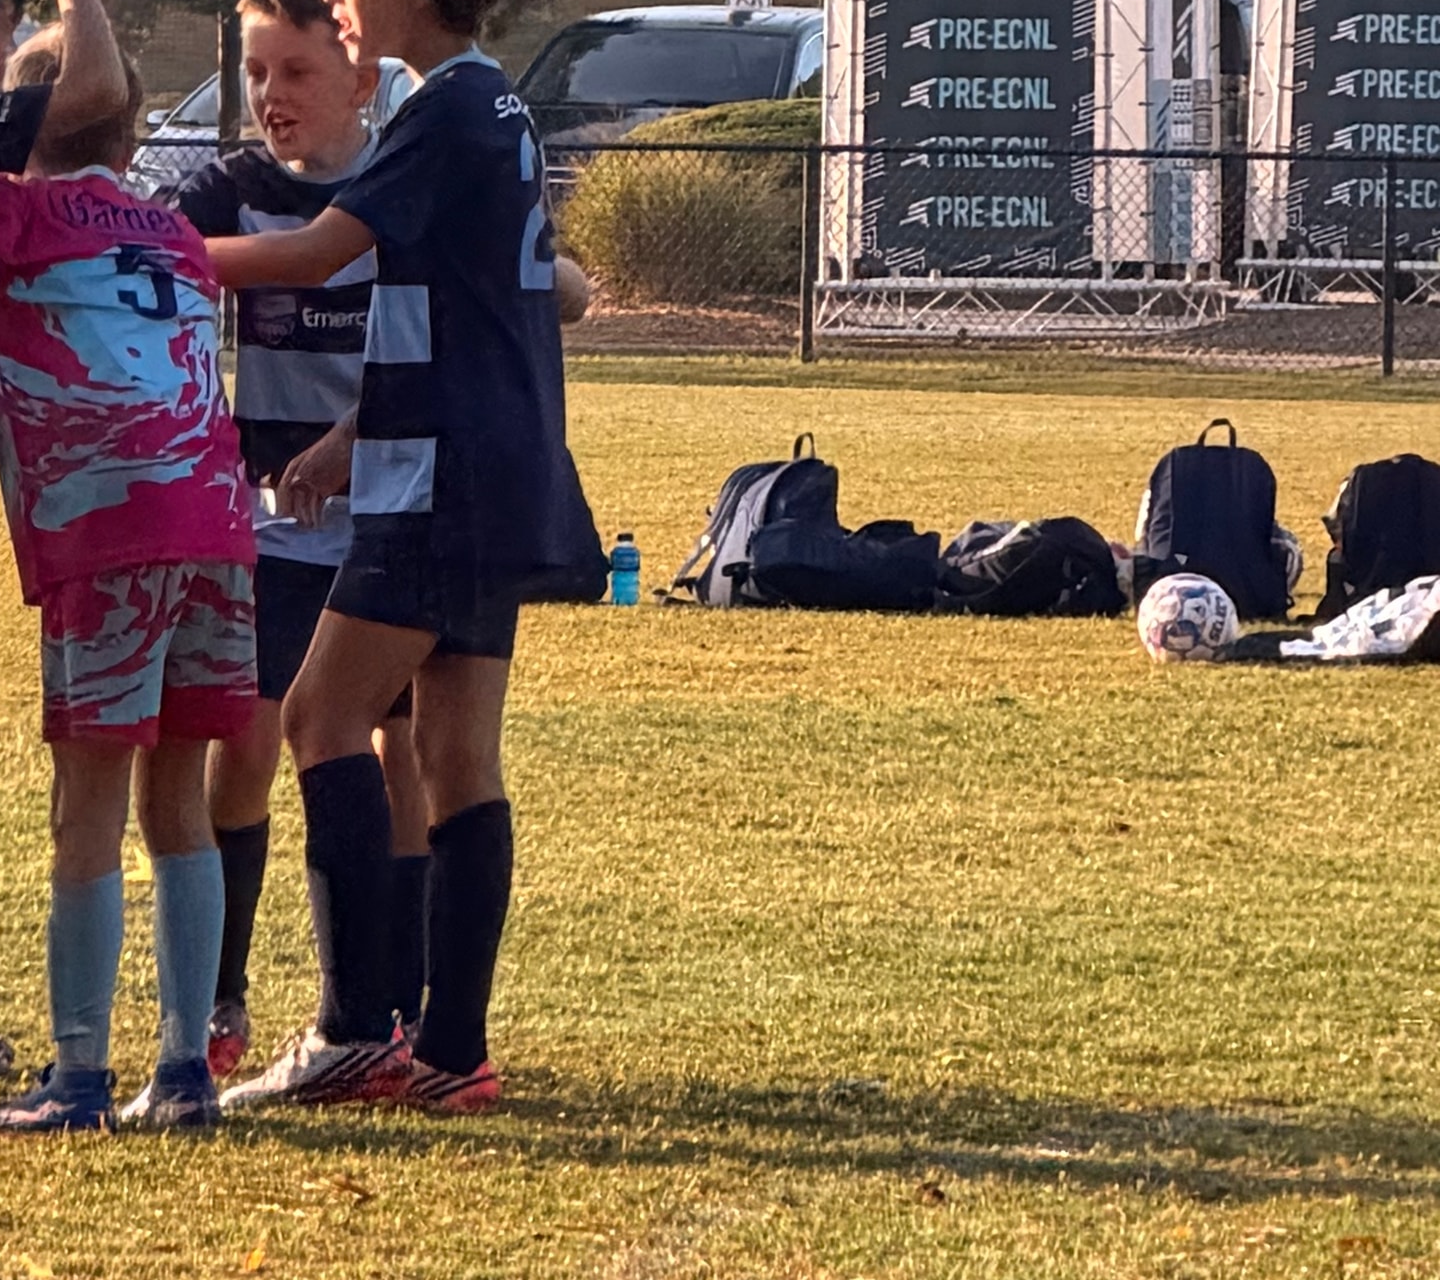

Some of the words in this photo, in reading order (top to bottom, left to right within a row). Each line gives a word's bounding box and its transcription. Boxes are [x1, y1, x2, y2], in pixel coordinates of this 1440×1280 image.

[938, 18, 1057, 50] PRE-ECNL
[937, 77, 1056, 109] PRE-ECNL
[1360, 122, 1440, 153] PRE-EC
[936, 196, 1053, 228] PRE-ECNL
[115, 244, 177, 320] 5
